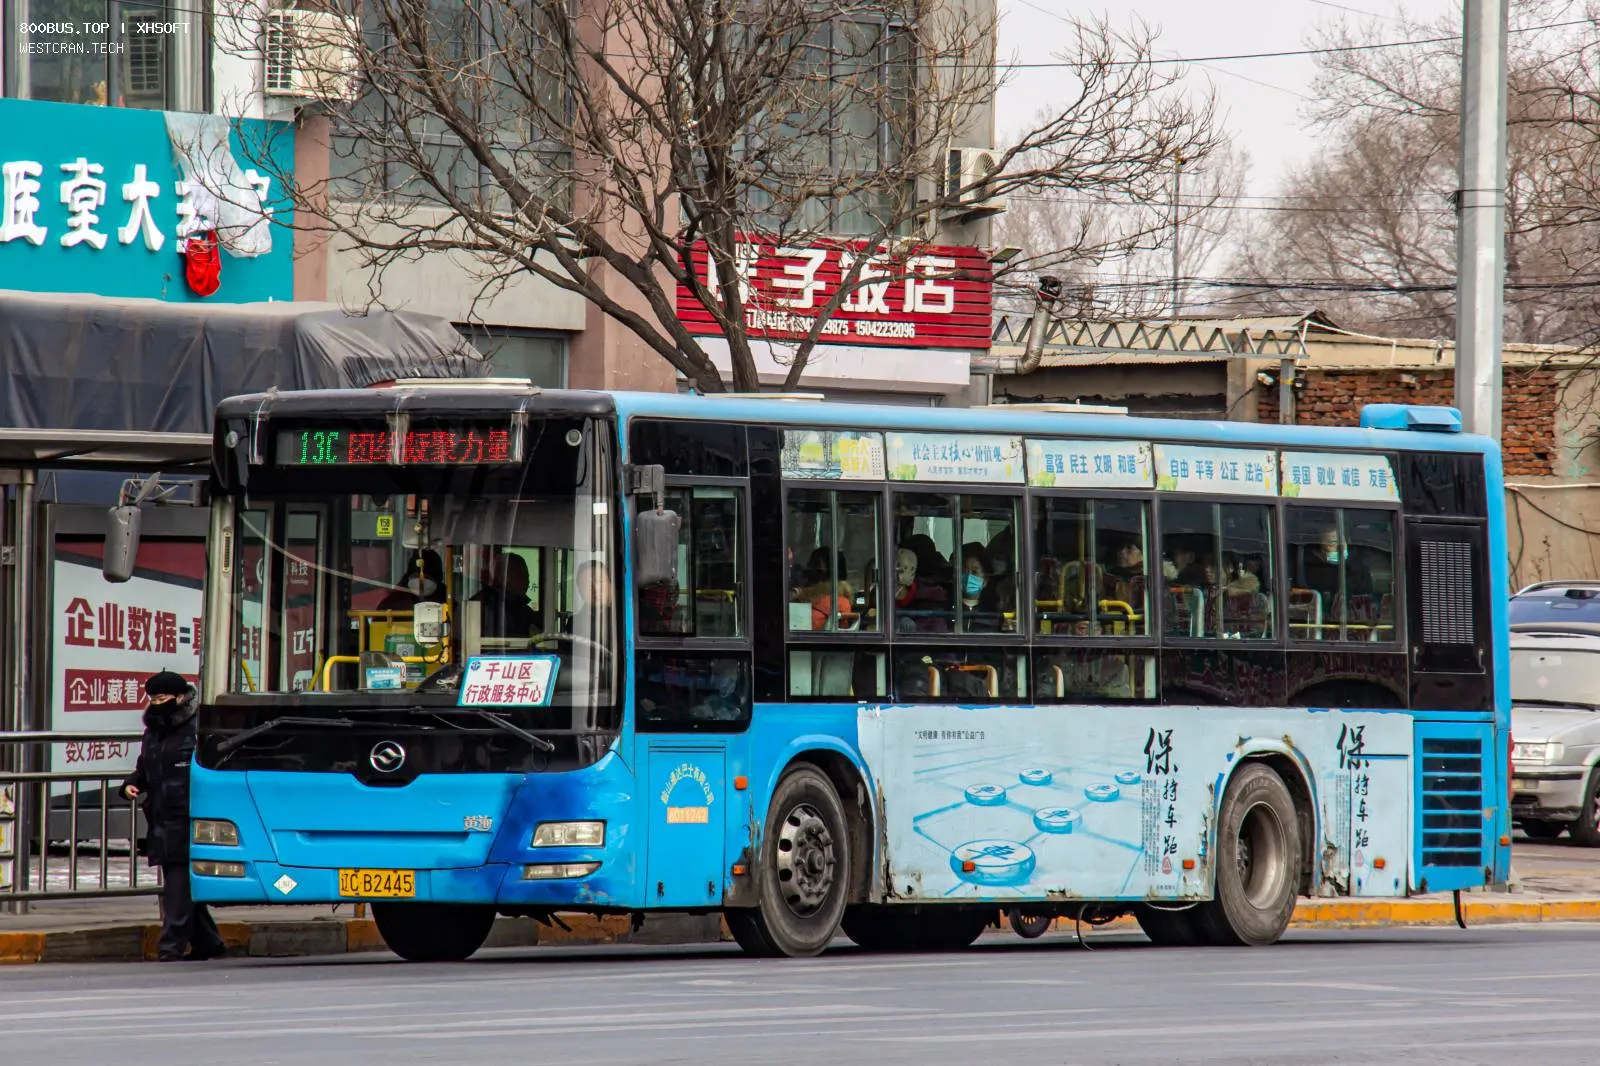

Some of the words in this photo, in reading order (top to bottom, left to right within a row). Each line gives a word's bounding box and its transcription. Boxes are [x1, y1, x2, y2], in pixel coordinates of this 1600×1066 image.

[0, 157, 274, 253] 医堂大
[855, 321, 915, 338] 15042232096
[1045, 454, 1064, 474] 富强
[1070, 454, 1088, 474] 民主
[1095, 454, 1113, 474] 文明
[1118, 454, 1137, 474] 和谐
[1171, 458, 1189, 478] 自由
[1195, 460, 1214, 480] 平等
[1220, 460, 1239, 481] 公正
[1245, 461, 1264, 482] 法治
[1292, 465, 1312, 486] 爱国
[1317, 466, 1336, 486] 敬业
[1368, 467, 1388, 488] 友善
[485, 662, 535, 681] 千山区
[465, 684, 543, 704] 行政服务中心
[65, 741, 129, 764] 数据资
